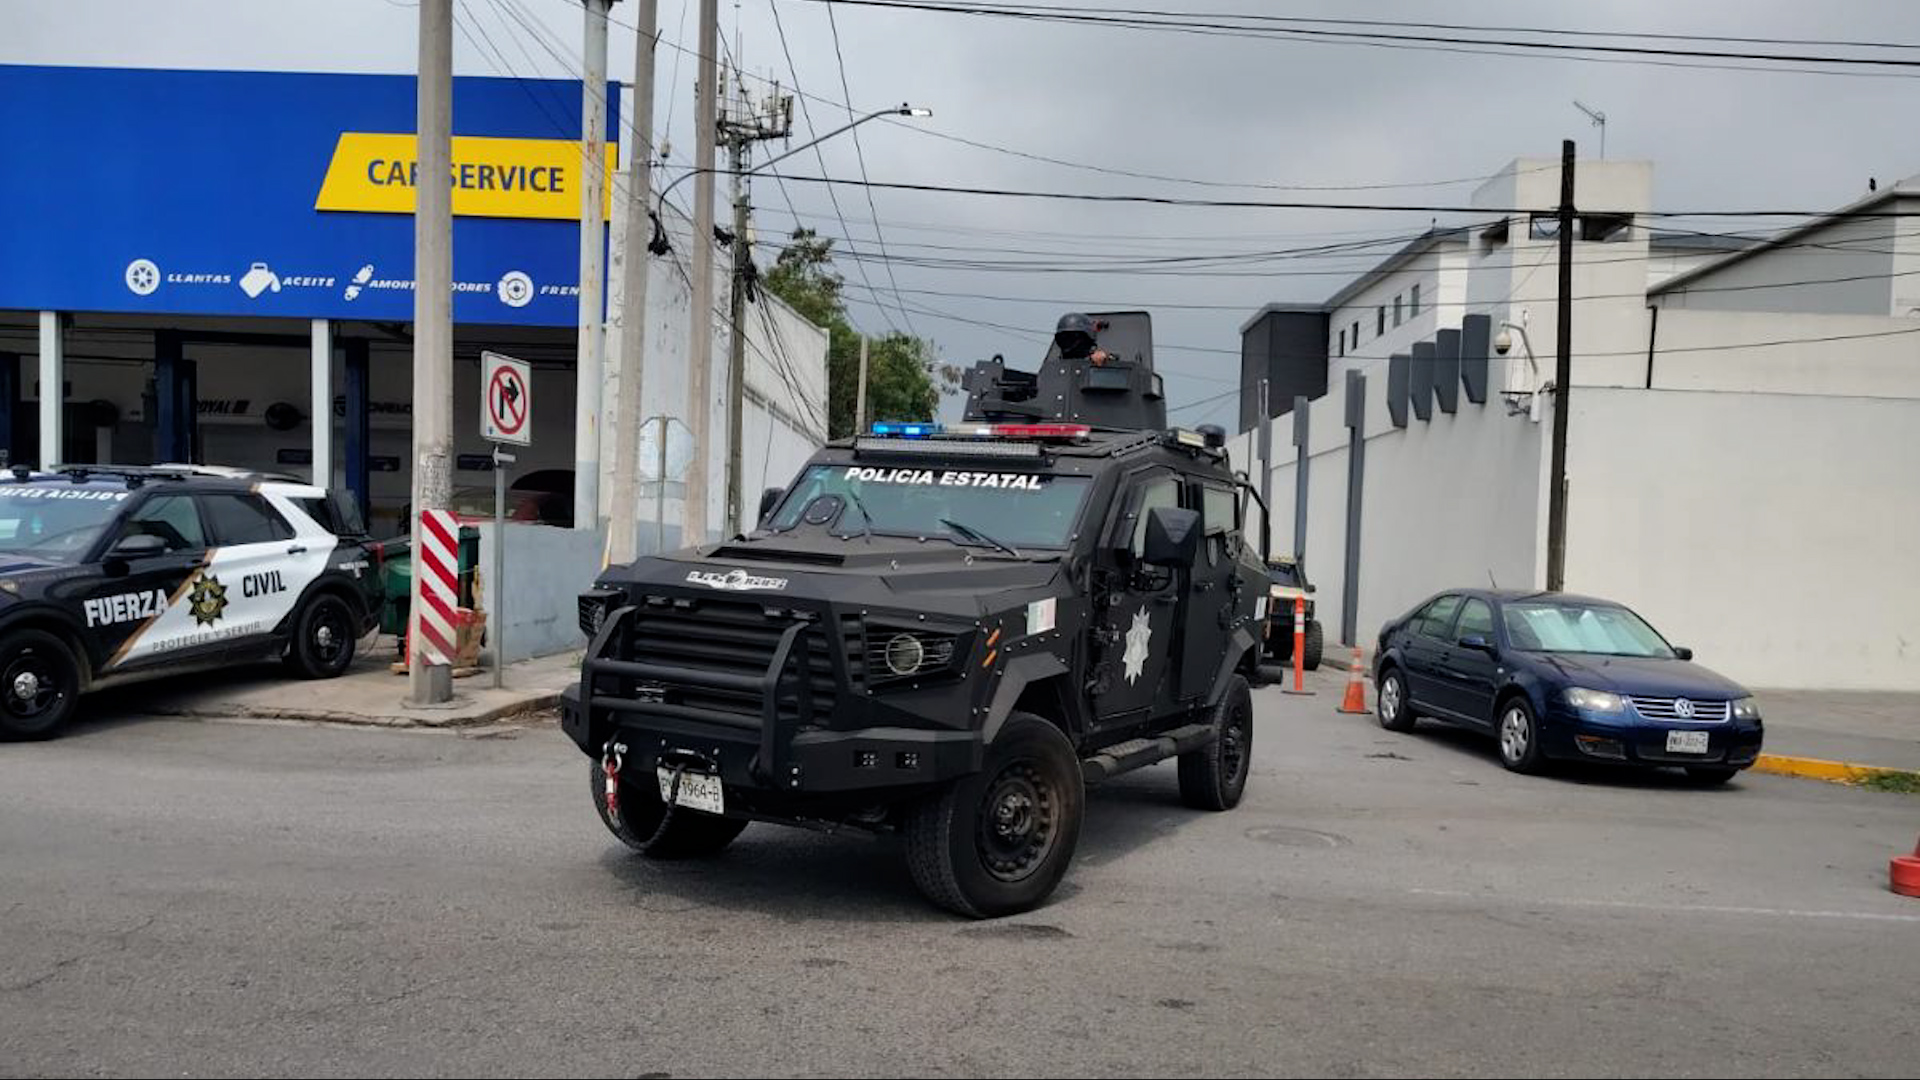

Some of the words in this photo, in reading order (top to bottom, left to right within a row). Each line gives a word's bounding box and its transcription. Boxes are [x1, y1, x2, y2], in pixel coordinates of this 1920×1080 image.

[167, 273, 231, 284] LLANTAS
[282, 276, 335, 287] ACEITE
[540, 285, 581, 296] FREN
[845, 467, 933, 485] POLICIA
[939, 471, 1042, 490] ESTATAL
[242, 570, 287, 598] CIVIL
[83, 588, 169, 628] FUERZA
[153, 632, 210, 651] PROTEGER
[225, 620, 261, 638] SERVIR
